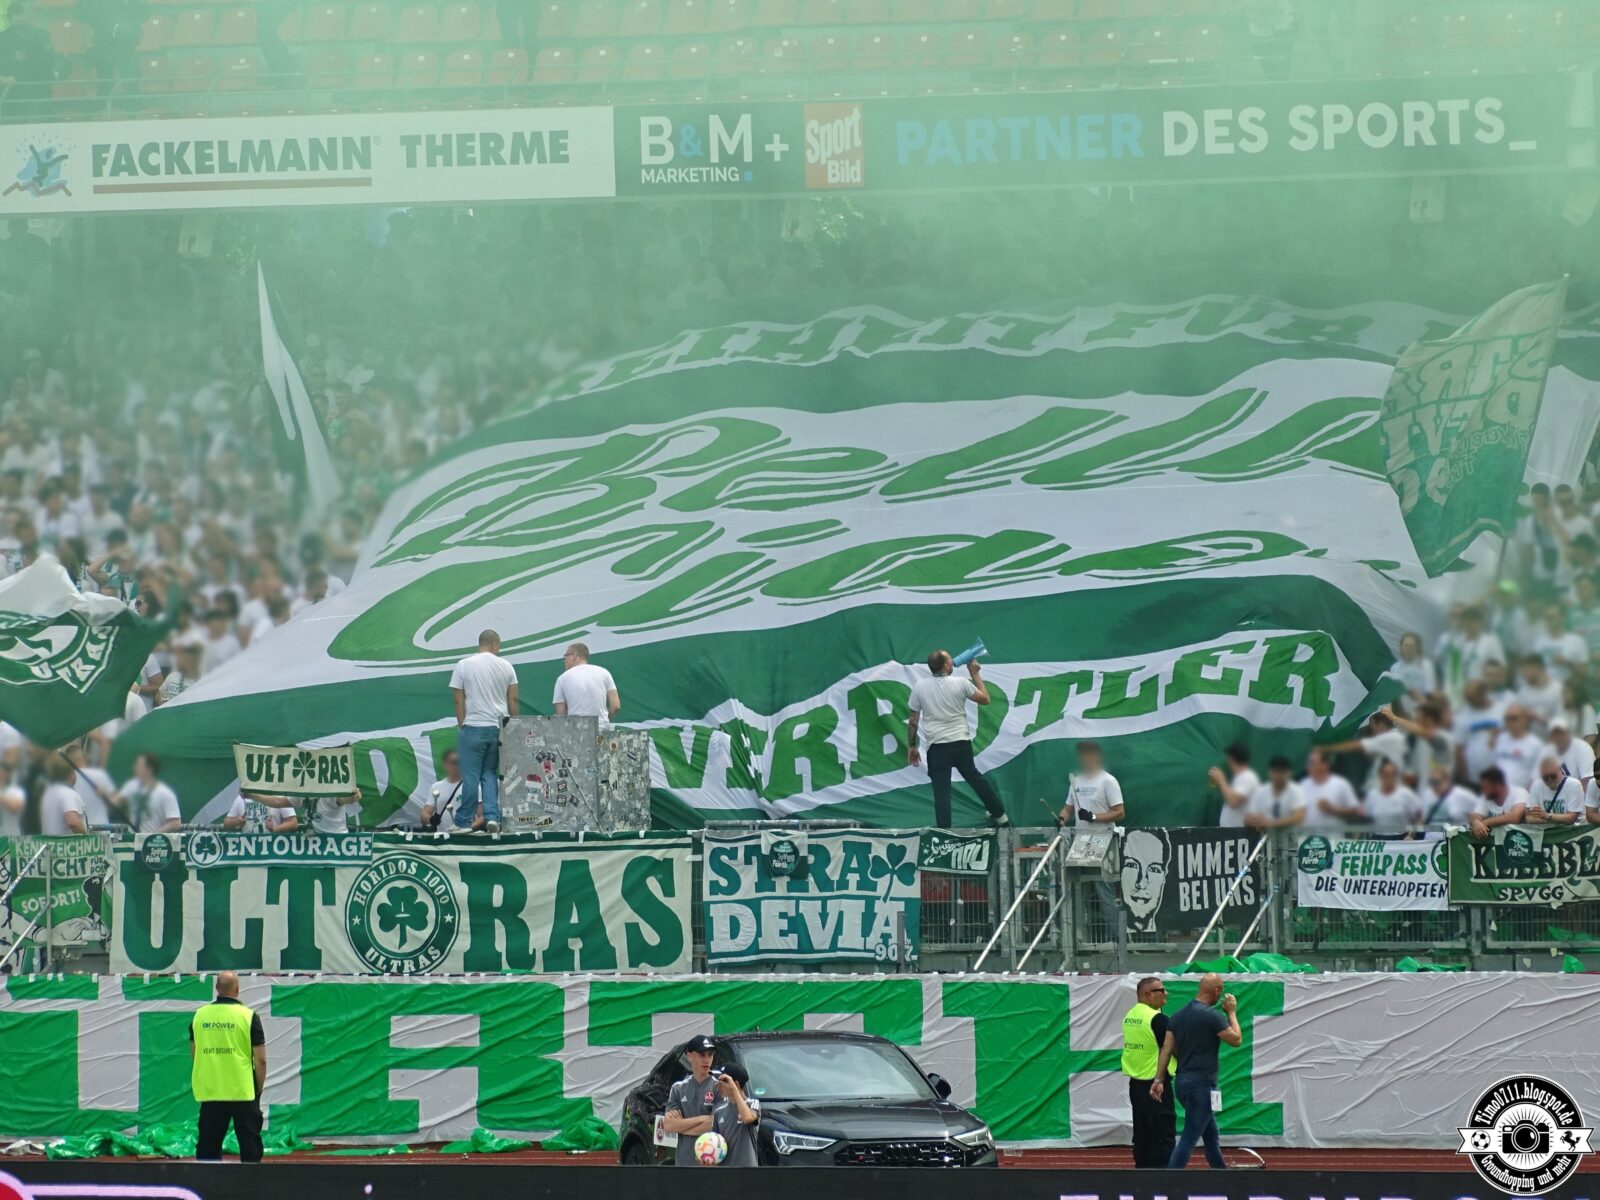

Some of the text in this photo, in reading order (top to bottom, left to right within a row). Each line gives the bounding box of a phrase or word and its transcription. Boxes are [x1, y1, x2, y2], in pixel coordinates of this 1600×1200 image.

[91, 130, 569, 177] FACKELMANN THERME
[640, 114, 753, 164] B&M
[806, 107, 862, 164] Sport
[895, 112, 1145, 165] PARTNER
[1163, 107, 1269, 156] DES
[827, 159, 861, 183] Bild
[326, 519, 1328, 668] Ciao
[226, 835, 373, 857] ENTOURAGE
[1177, 838, 1251, 879] IMMER
[1334, 841, 1386, 854] SEKTION
[18, 857, 87, 877] PFLCHT
[353, 860, 450, 906] HORIDOS 1000
[1340, 853, 1428, 877] FEHLPASS
[1179, 875, 1255, 912] BEI UNS
[1315, 876, 1448, 898] DIE UNTERHOPFTEN
[1498, 885, 1565, 901] SPVGG
[710, 900, 912, 952] DEVIA
[364, 945, 441, 973] ULTRAS
